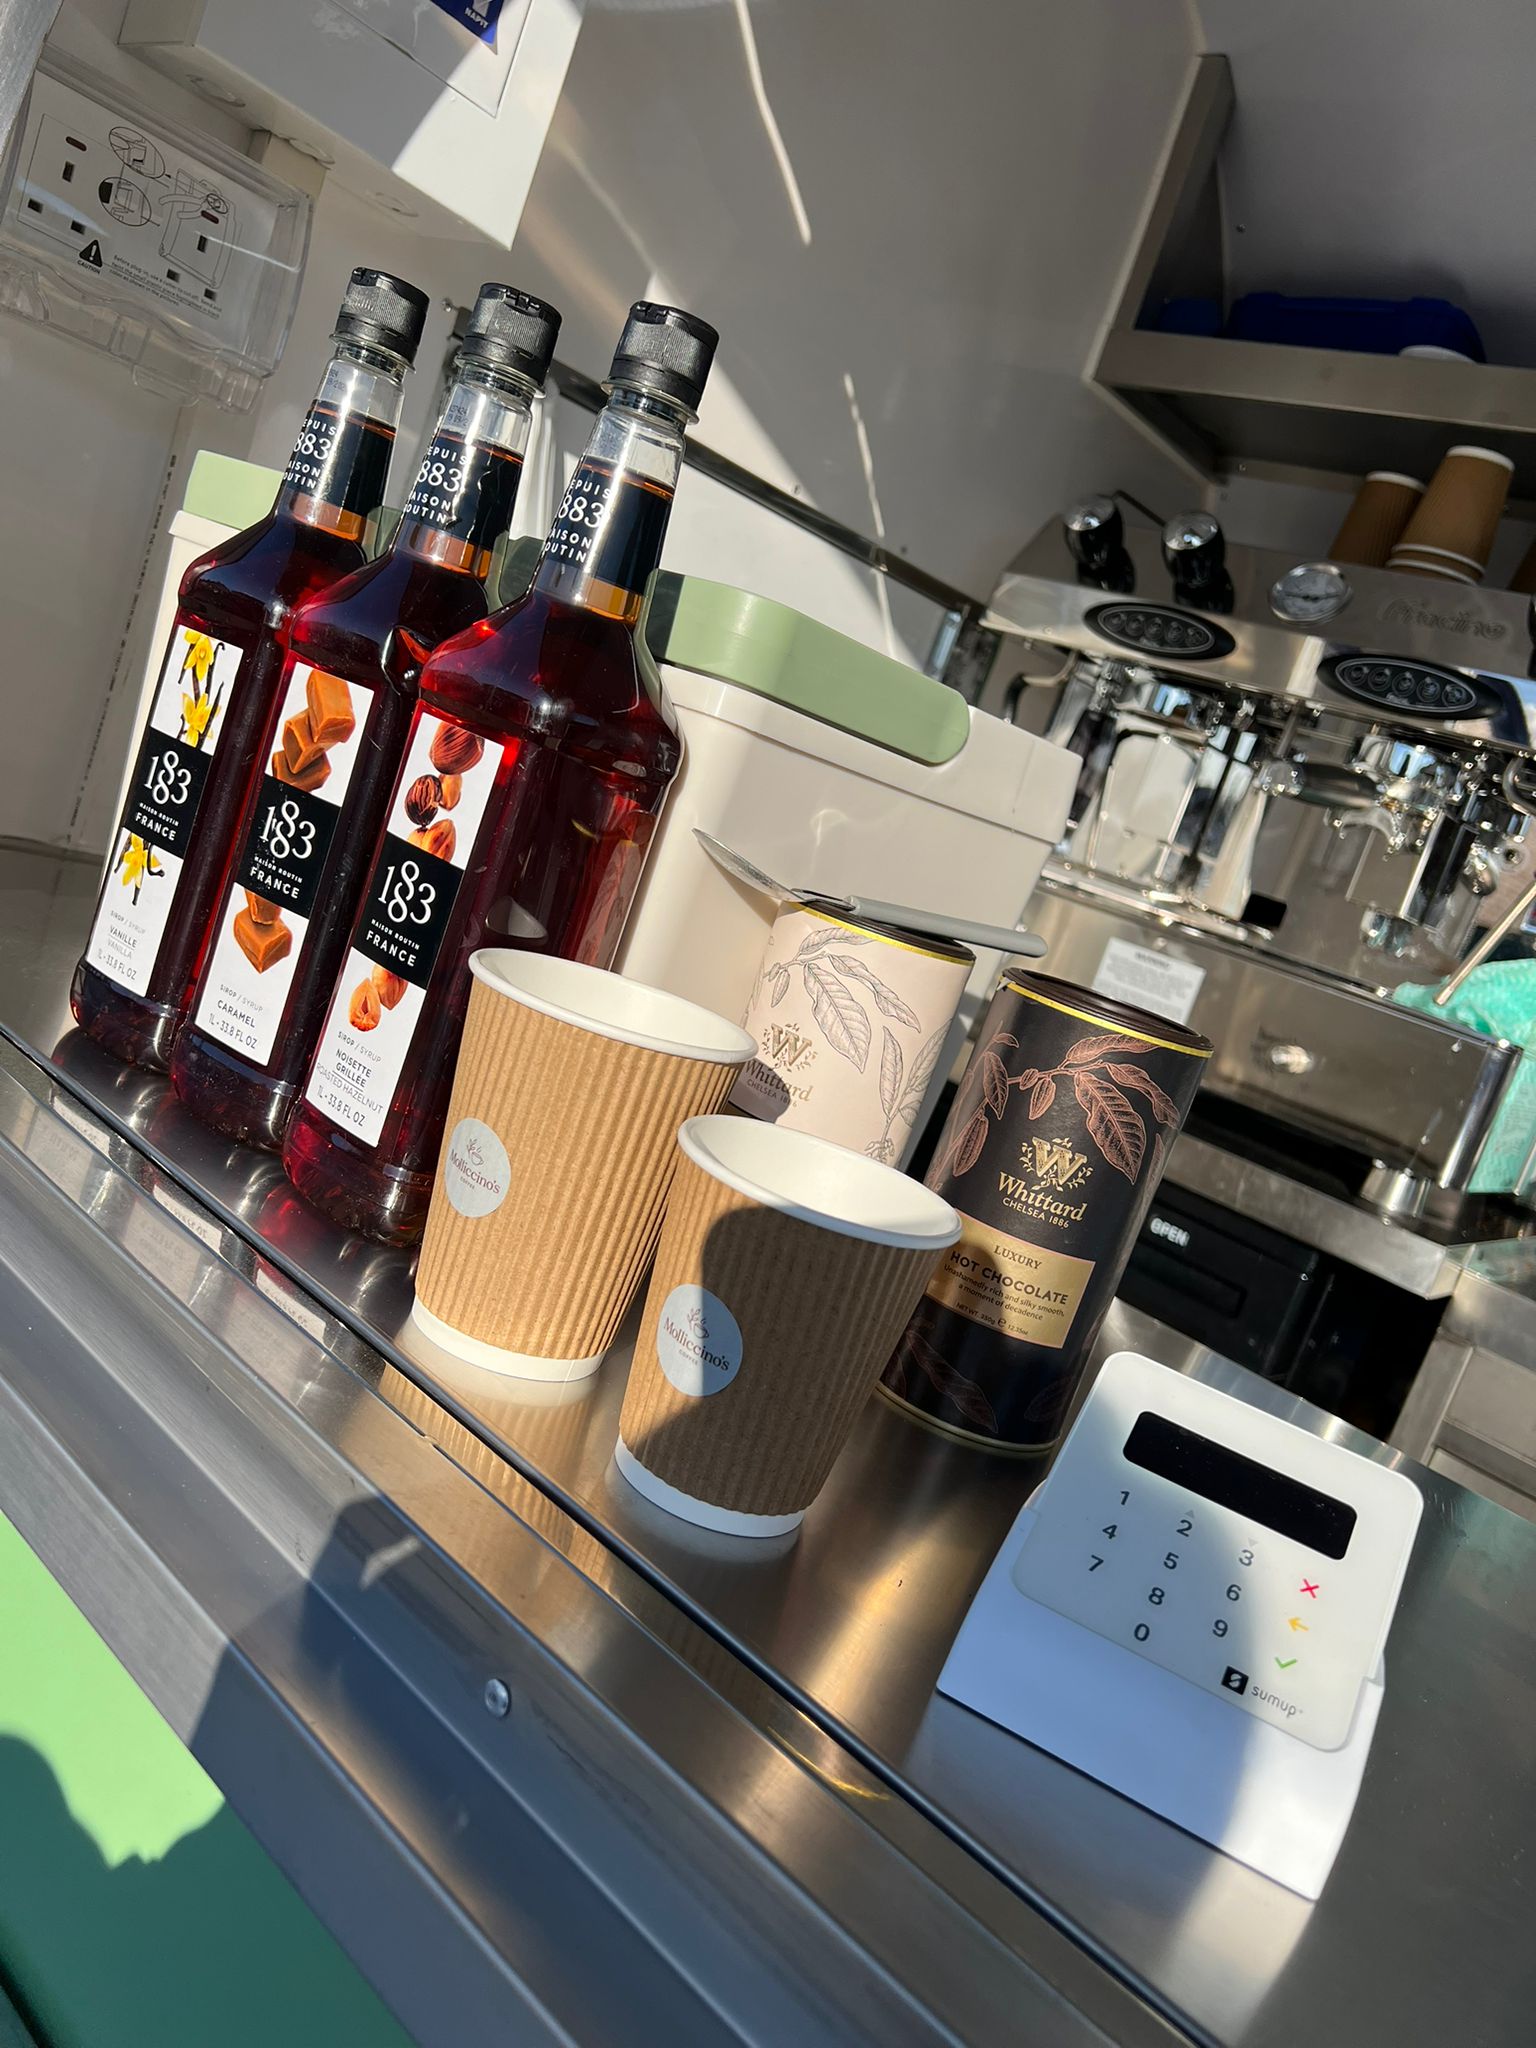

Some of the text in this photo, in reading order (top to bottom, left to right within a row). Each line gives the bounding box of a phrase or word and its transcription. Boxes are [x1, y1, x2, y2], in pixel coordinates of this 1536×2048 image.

[77, 259, 101, 275] CAUTION
[302, 418, 336, 436] EPUIS
[293, 432, 331, 460] 883
[427, 446, 470, 465] EPUIS
[283, 472, 316, 489] OUTIN
[417, 460, 462, 492] 883
[570, 479, 611, 499] EPUIS
[405, 504, 447, 524] OUTIN
[411, 491, 451, 512] AISON
[558, 495, 604, 528] 883
[545, 542, 586, 563] OUTIN
[550, 529, 592, 549] AISON
[135, 812, 177, 841] FRANCE
[250, 866, 300, 899] FRANCE
[107, 938, 132, 960] VANILLA
[110, 925, 137, 948] VANILLE
[366, 930, 416, 967] FRANCE
[118, 962, 125, 975] FL
[126, 967, 137, 981] OZ
[217, 999, 256, 1029] CARAMEL
[235, 1029, 244, 1043] FL
[245, 1035, 258, 1050] OZ
[336, 1049, 372, 1078] NOISETTE
[317, 1062, 384, 1114] ROASTED HAZELNUT
[746, 1058, 814, 1102] Whittard
[747, 1078, 777, 1099] CHELSEA
[342, 1104, 352, 1119] FL
[353, 1111, 366, 1127] OZ
[450, 1149, 501, 1194] Molliccino's
[999, 1171, 1088, 1221] Whittard
[1002, 1197, 1069, 1228] CHELSEA 1886
[1150, 1217, 1190, 1247] OPEN
[994, 1245, 1042, 1270] LUXURY
[944, 1264, 989, 1292] Unashamedly
[989, 1287, 1004, 1298] rich
[1004, 1293, 1020, 1303] and
[1020, 1299, 1037, 1310] silky
[950, 1250, 1069, 1305] HOT CHOCOLATE
[964, 1286, 994, 1304] moment
[995, 1299, 1004, 1307] of
[1004, 1303, 1044, 1321] decadence
[664, 1316, 730, 1371] Molliccino's
[1120, 1490, 1255, 1567] 1 2 3
[1102, 1523, 1242, 1602] 4 5 6
[1088, 1554, 1228, 1638] 7 8 9
[1133, 1622, 1151, 1642] 0
